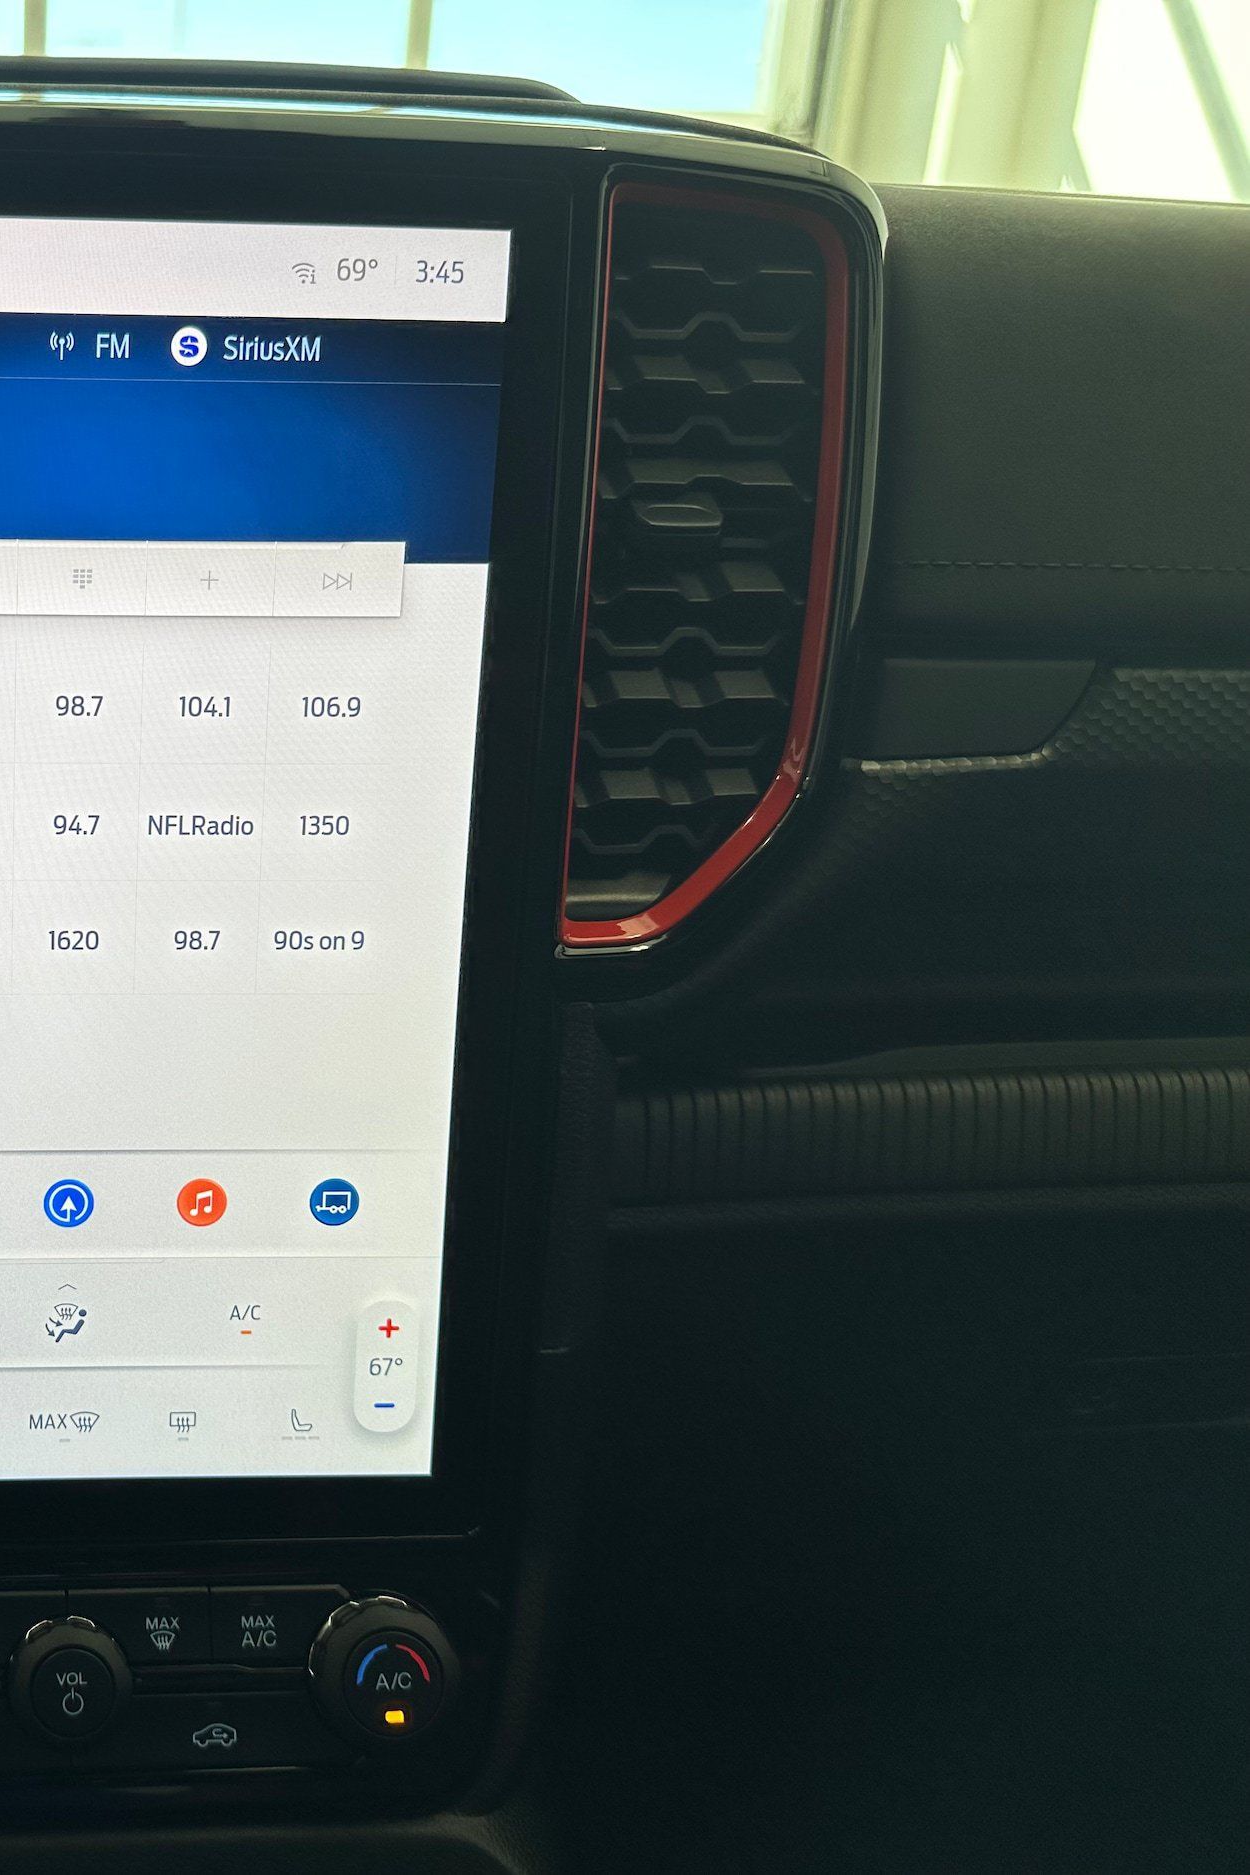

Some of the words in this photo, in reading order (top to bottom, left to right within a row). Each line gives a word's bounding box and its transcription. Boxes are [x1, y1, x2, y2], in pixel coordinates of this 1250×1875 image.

[335, 257, 380, 283] 69°
[414, 259, 465, 285] 3:45
[95, 332, 131, 360] FM
[222, 335, 322, 362] SiriusXM
[54, 695, 105, 718] 98.7
[178, 695, 232, 719] 104.1
[301, 696, 362, 719] 106.9
[52, 814, 101, 837] 94.7
[147, 814, 255, 837] NFLRadio
[299, 814, 350, 837] 1350
[47, 930, 100, 952] 1620
[173, 930, 222, 952] 98.7
[273, 930, 314, 952] 90s
[319, 934, 346, 952] on
[350, 930, 366, 952] 9
[229, 1304, 262, 1322] A/C
[368, 1357, 404, 1377] 67°
[28, 1412, 69, 1431] MAX
[145, 1616, 181, 1631] MAX
[240, 1614, 276, 1629] MAX
[241, 1631, 278, 1648] A/C
[56, 1672, 88, 1686] VOL
[375, 1672, 413, 1691] A/C
